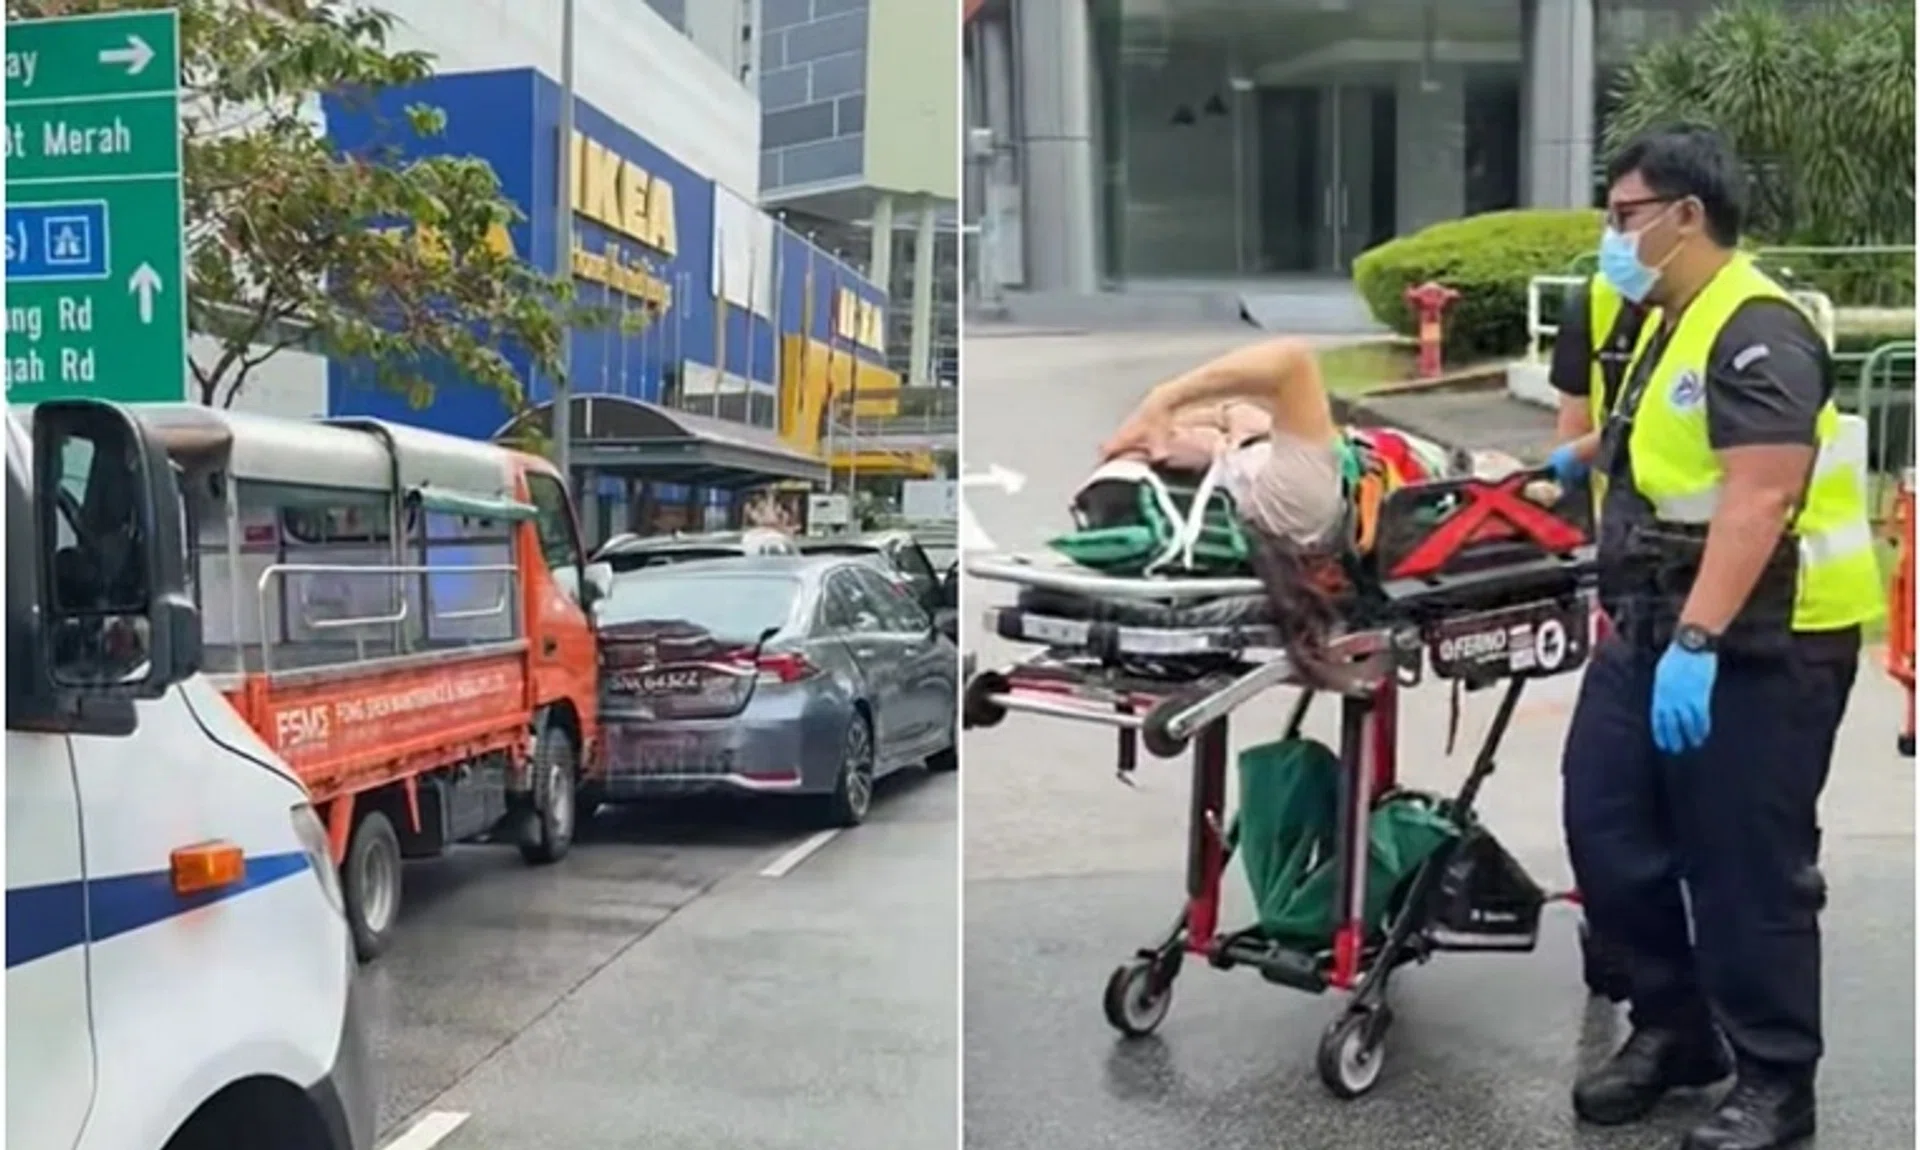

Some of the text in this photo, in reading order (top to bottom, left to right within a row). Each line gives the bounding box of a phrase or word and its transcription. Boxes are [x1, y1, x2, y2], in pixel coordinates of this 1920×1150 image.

[44, 115, 131, 155] Merah
[571, 129, 677, 257] IKEA
[60, 296, 92, 331] Rd
[62, 347, 94, 381] Rd
[1455, 628, 1506, 658] FERNO
